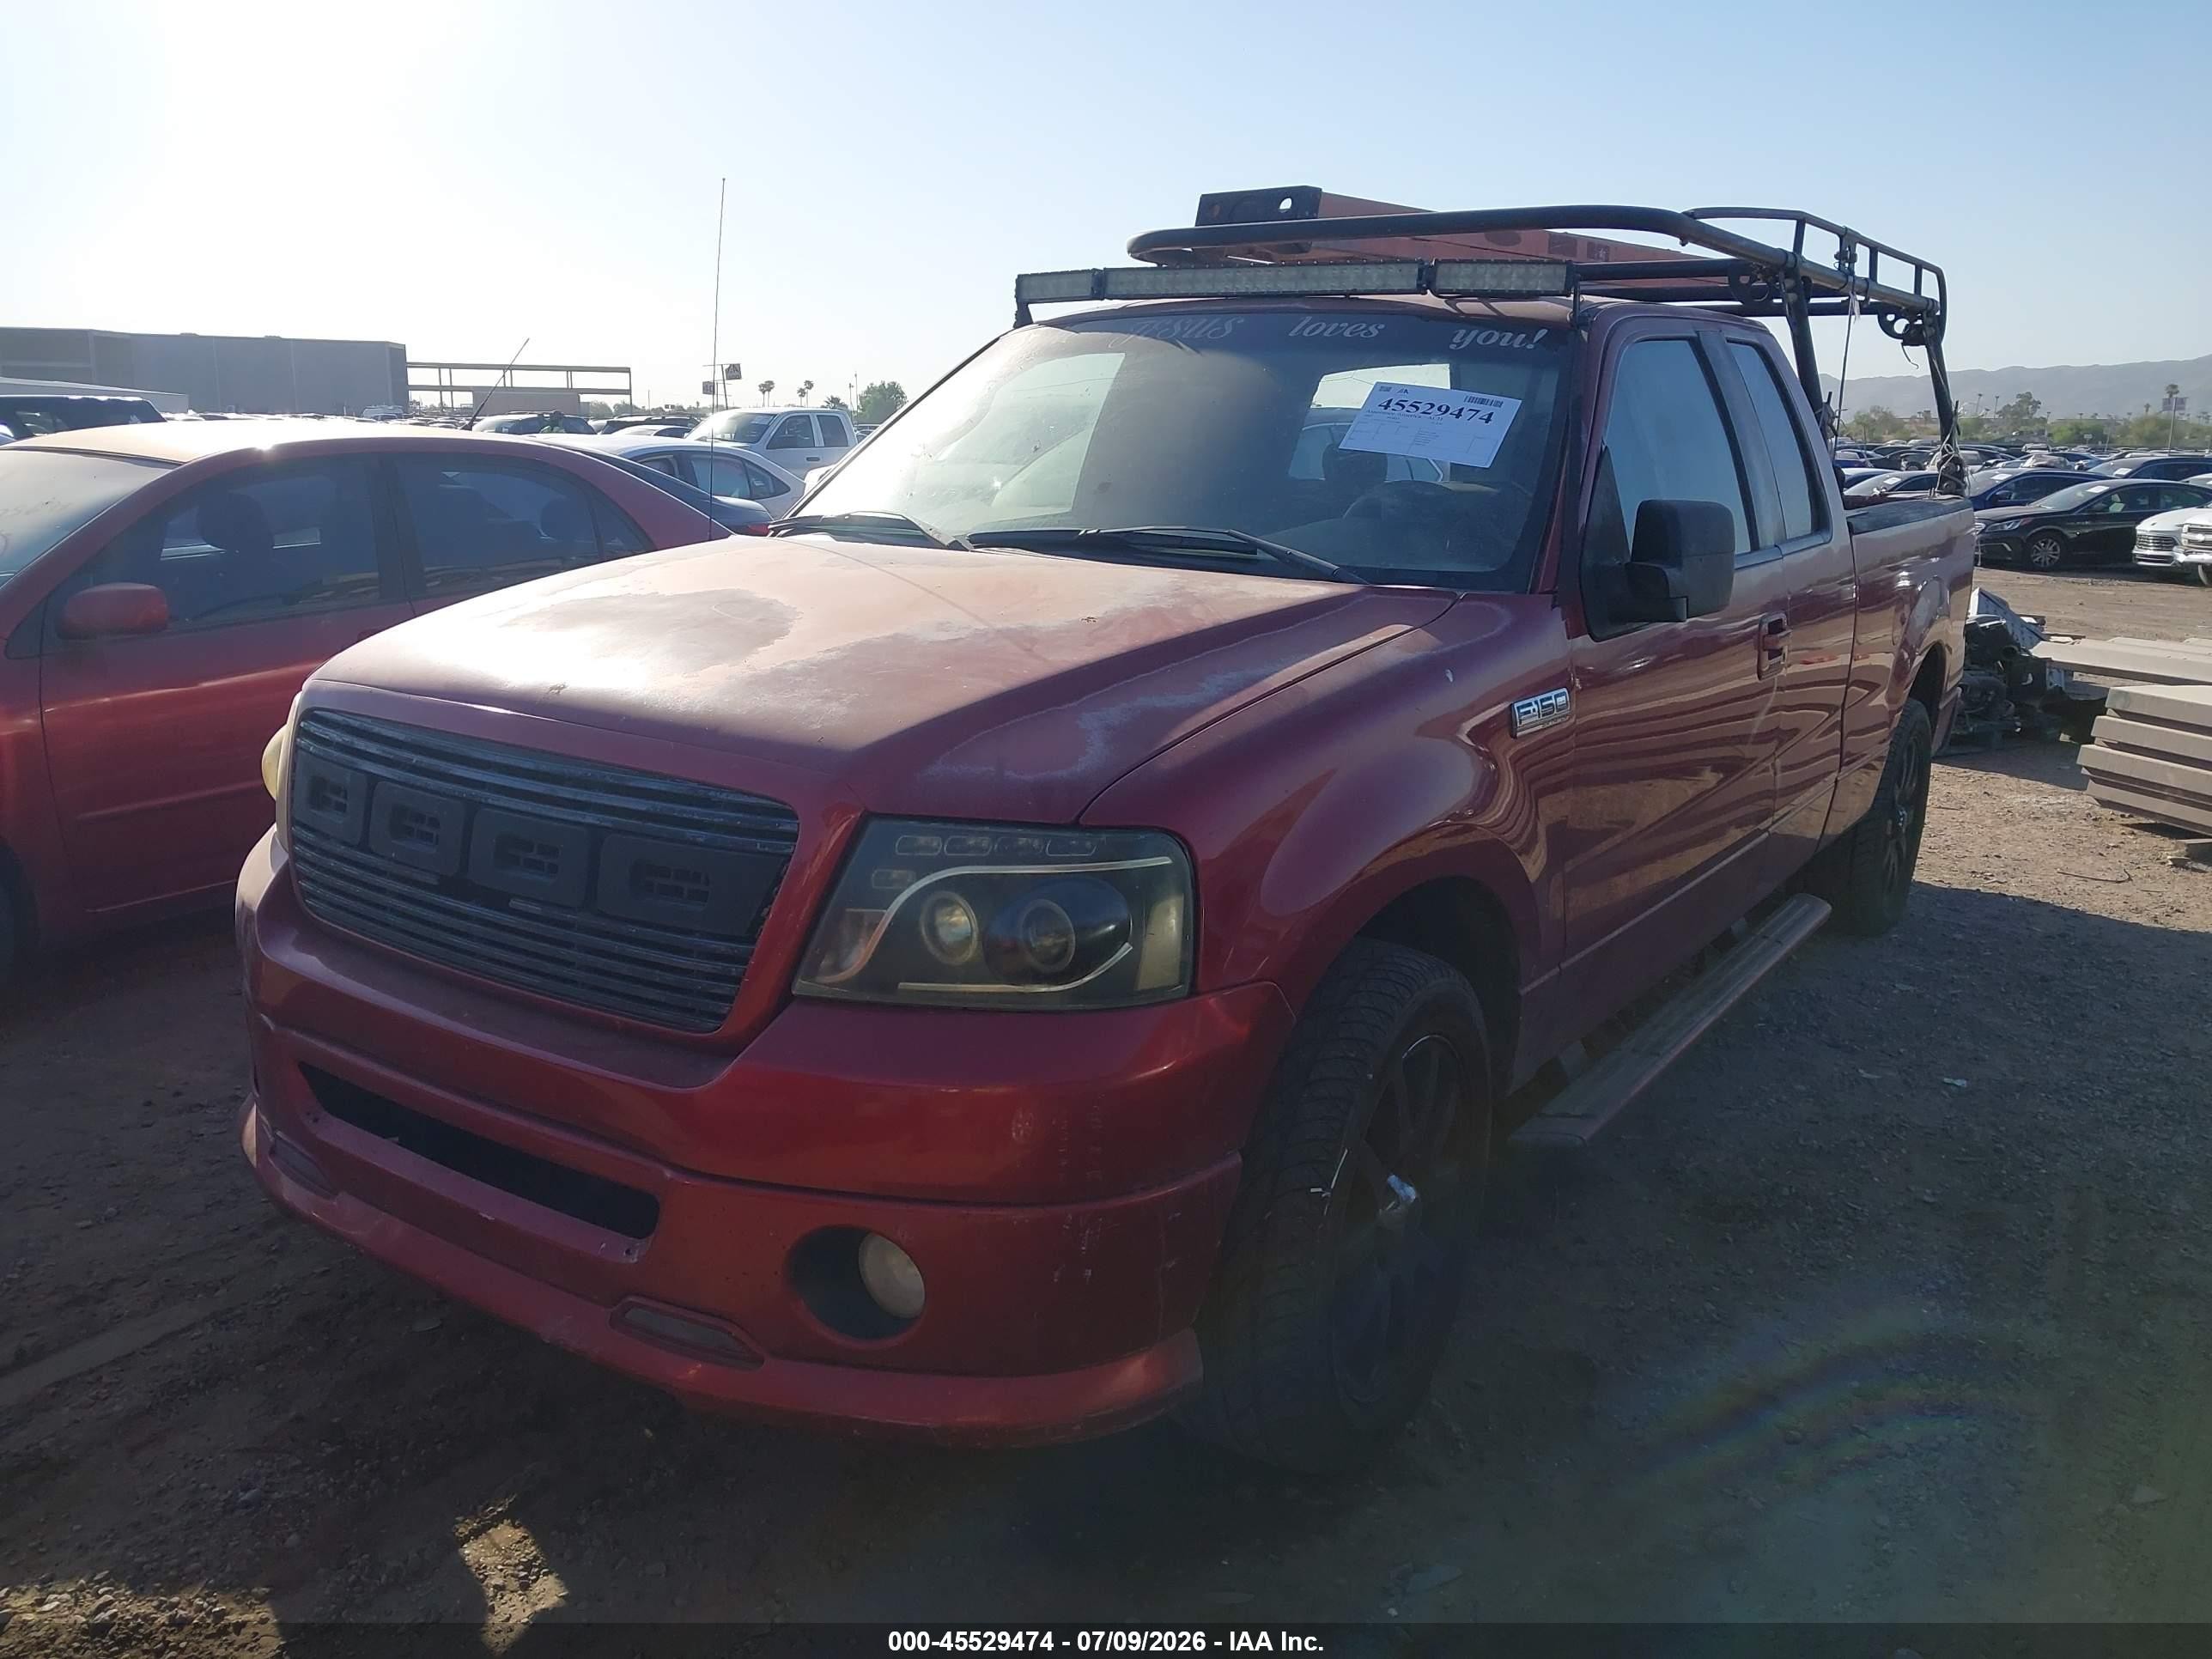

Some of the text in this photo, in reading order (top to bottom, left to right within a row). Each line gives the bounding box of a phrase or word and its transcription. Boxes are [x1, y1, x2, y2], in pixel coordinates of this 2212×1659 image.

[1288, 316, 1386, 337] loves
[1449, 328, 1549, 350] you!
[1377, 398, 1494, 424] 45529474
